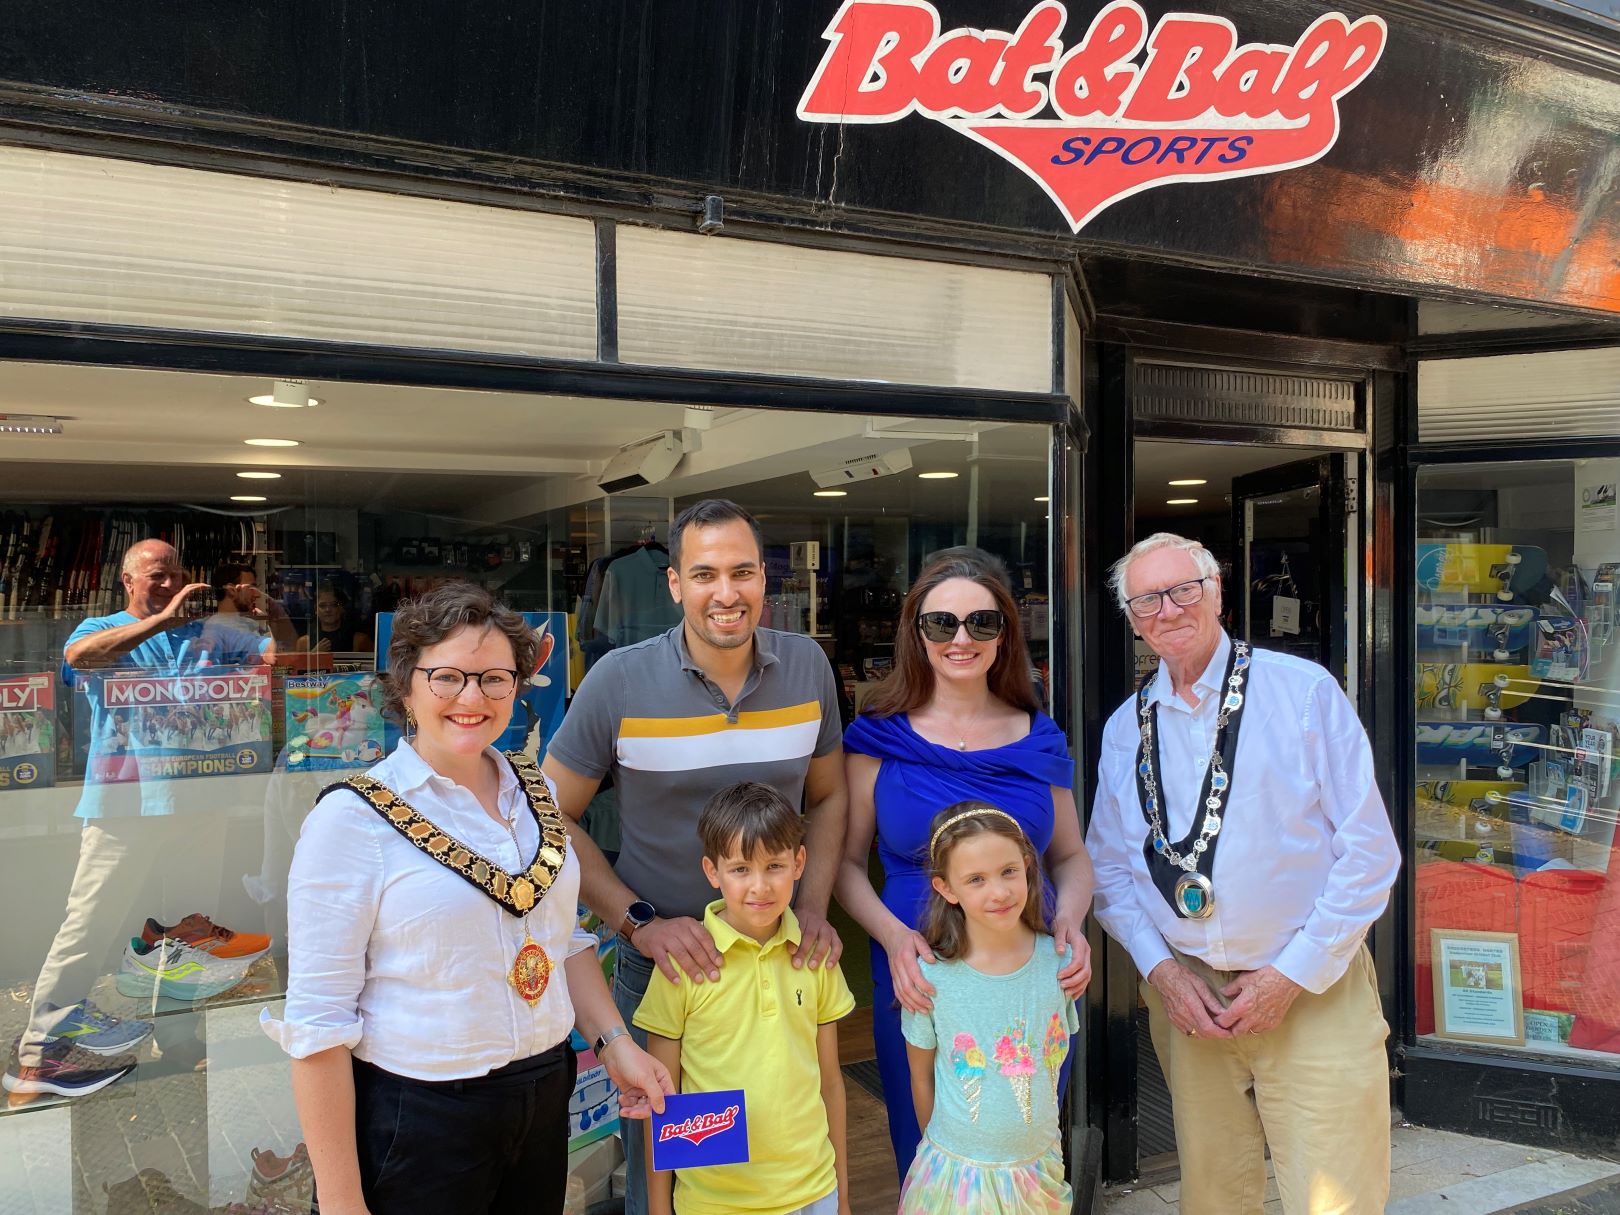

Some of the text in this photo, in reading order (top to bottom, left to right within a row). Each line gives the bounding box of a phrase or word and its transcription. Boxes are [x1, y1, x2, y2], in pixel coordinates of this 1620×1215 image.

[1051, 136, 1253, 166] SPORTS
[110, 679, 252, 703] MONOPOLY
[288, 680, 328, 689] Bestway
